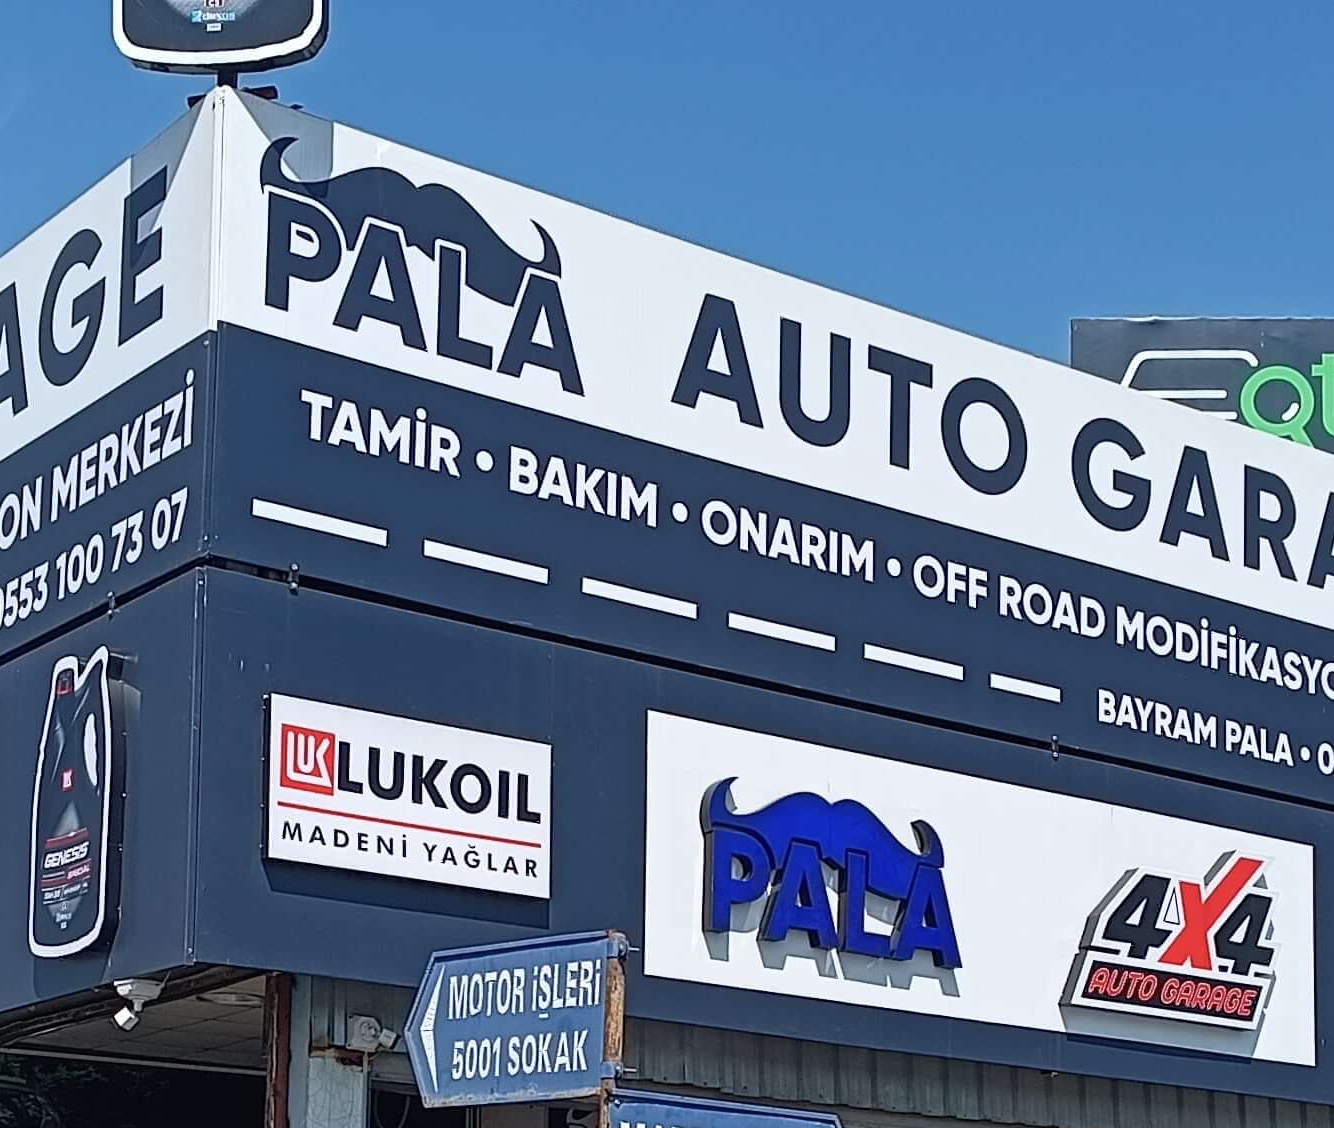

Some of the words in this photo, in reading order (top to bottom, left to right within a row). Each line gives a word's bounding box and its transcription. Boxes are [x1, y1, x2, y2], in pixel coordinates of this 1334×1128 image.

[264, 190, 585, 397] PALA
[670, 293, 1029, 496] AUTO
[50, 369, 195, 522] MERKEZİ
[56, 534, 104, 601] 100
[111, 510, 144, 574] 73
[151, 487, 189, 551] 07
[300, 388, 461, 478] TAMİR
[507, 446, 659, 529] BAKIM
[700, 500, 875, 584] ONARIM
[912, 554, 988, 610] OFF
[998, 576, 1107, 639] ROAD
[1098, 688, 1218, 748] BAYRAM
[1224, 722, 1294, 766] PALA
[338, 741, 541, 825] LUKOIL
[281, 820, 408, 858] MADENİ
[423, 843, 538, 879] YAĞLAR
[707, 828, 962, 969] PALA
[448, 967, 525, 1021] MOTOR
[1088, 967, 1155, 1004] AUTO
[1160, 981, 1256, 1018] GARAGE
[451, 1036, 501, 1080] 5001
[507, 1030, 588, 1076] SOKAK
